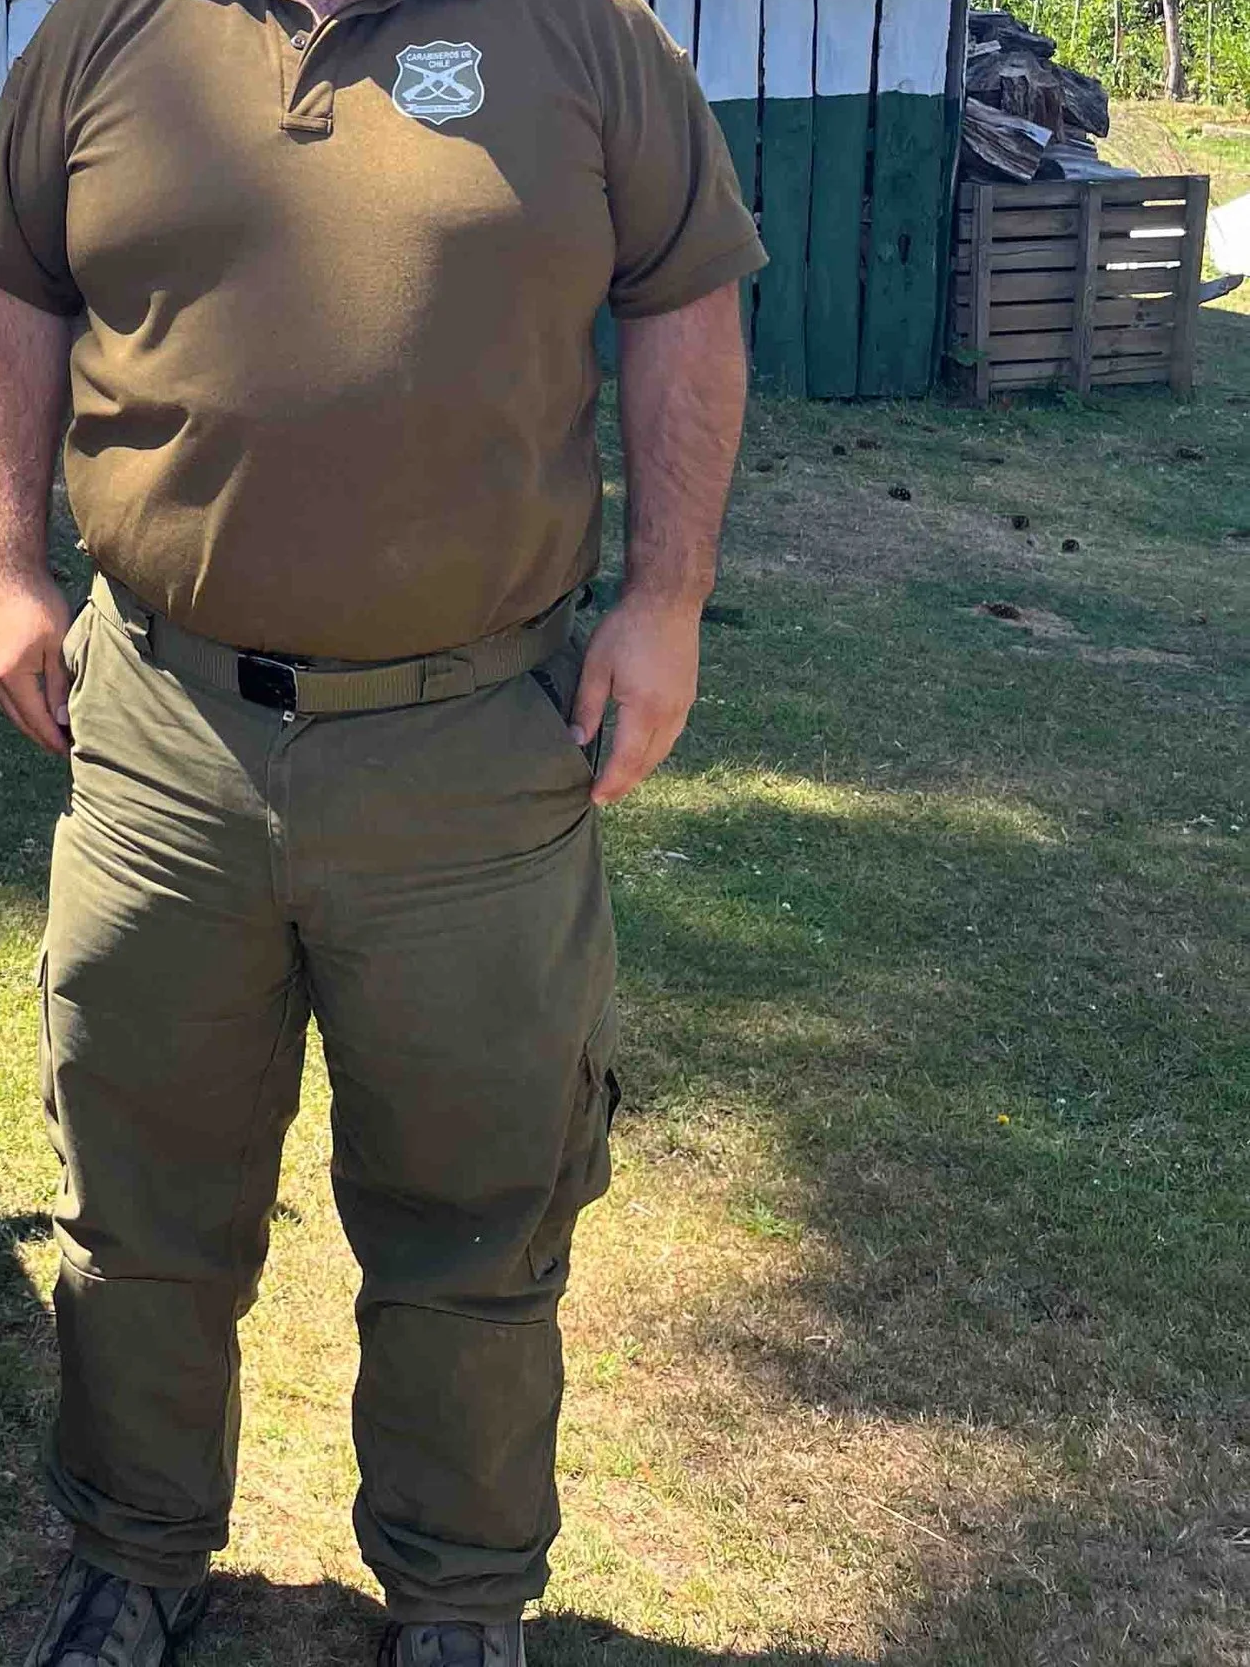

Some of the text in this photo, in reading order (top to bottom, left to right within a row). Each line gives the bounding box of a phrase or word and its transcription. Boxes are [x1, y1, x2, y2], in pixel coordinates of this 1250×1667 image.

[406, 50, 471, 61] CARABINEROS DE
[429, 59, 450, 68] CHILE
